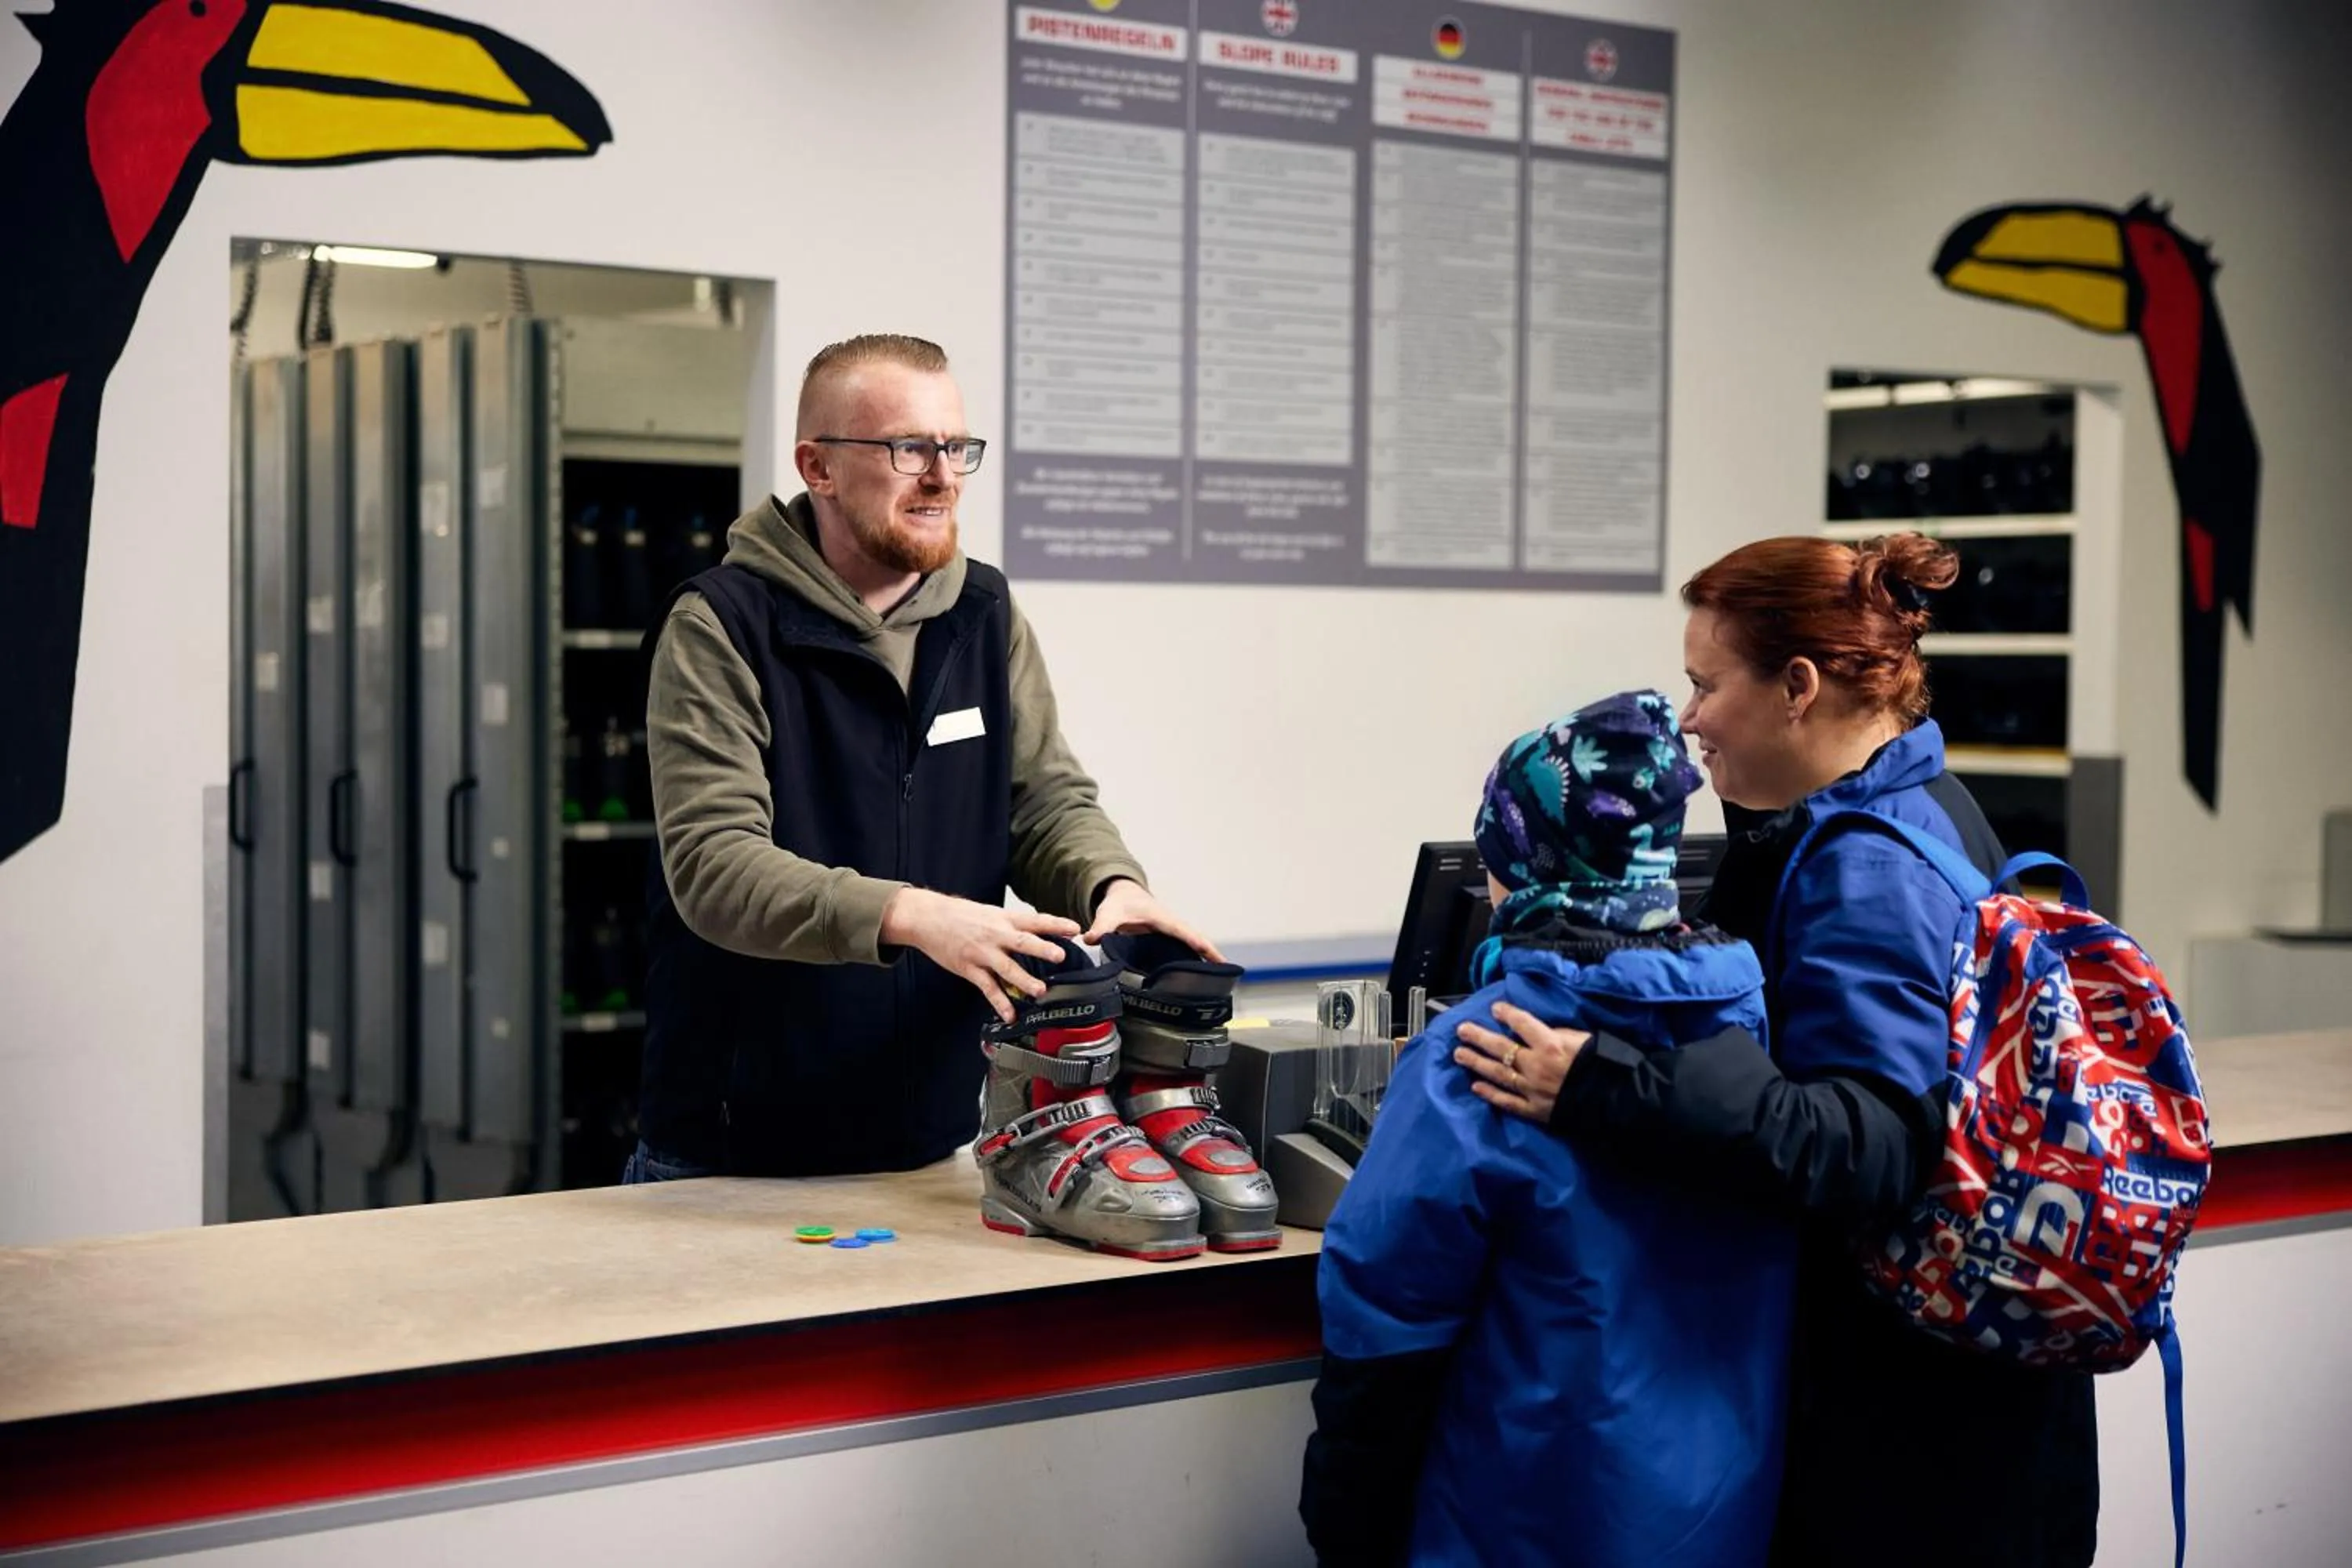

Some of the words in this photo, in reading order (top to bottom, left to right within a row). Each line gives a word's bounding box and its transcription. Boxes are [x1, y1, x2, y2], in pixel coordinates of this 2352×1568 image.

[1026, 14, 1176, 52] PISTENREGELN
[1218, 42, 1273, 66] SLOPE
[1283, 49, 1341, 74] RULES
[2102, 1165, 2202, 1206] Reebo
